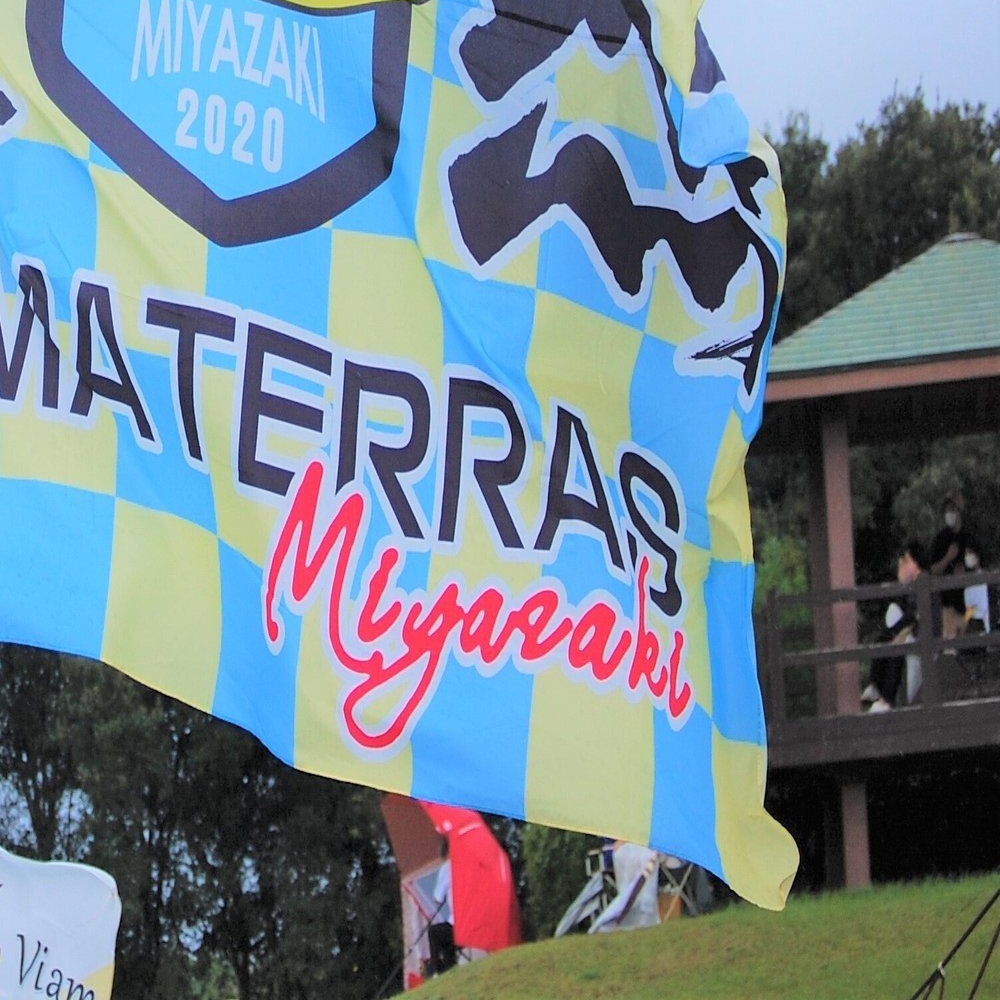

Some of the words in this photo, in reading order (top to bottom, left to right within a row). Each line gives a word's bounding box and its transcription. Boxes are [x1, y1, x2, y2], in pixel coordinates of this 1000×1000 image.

[175, 88, 284, 174] 2020
[266, 461, 691, 749] Miyazaki
[16, 934, 95, 1000] Viam
